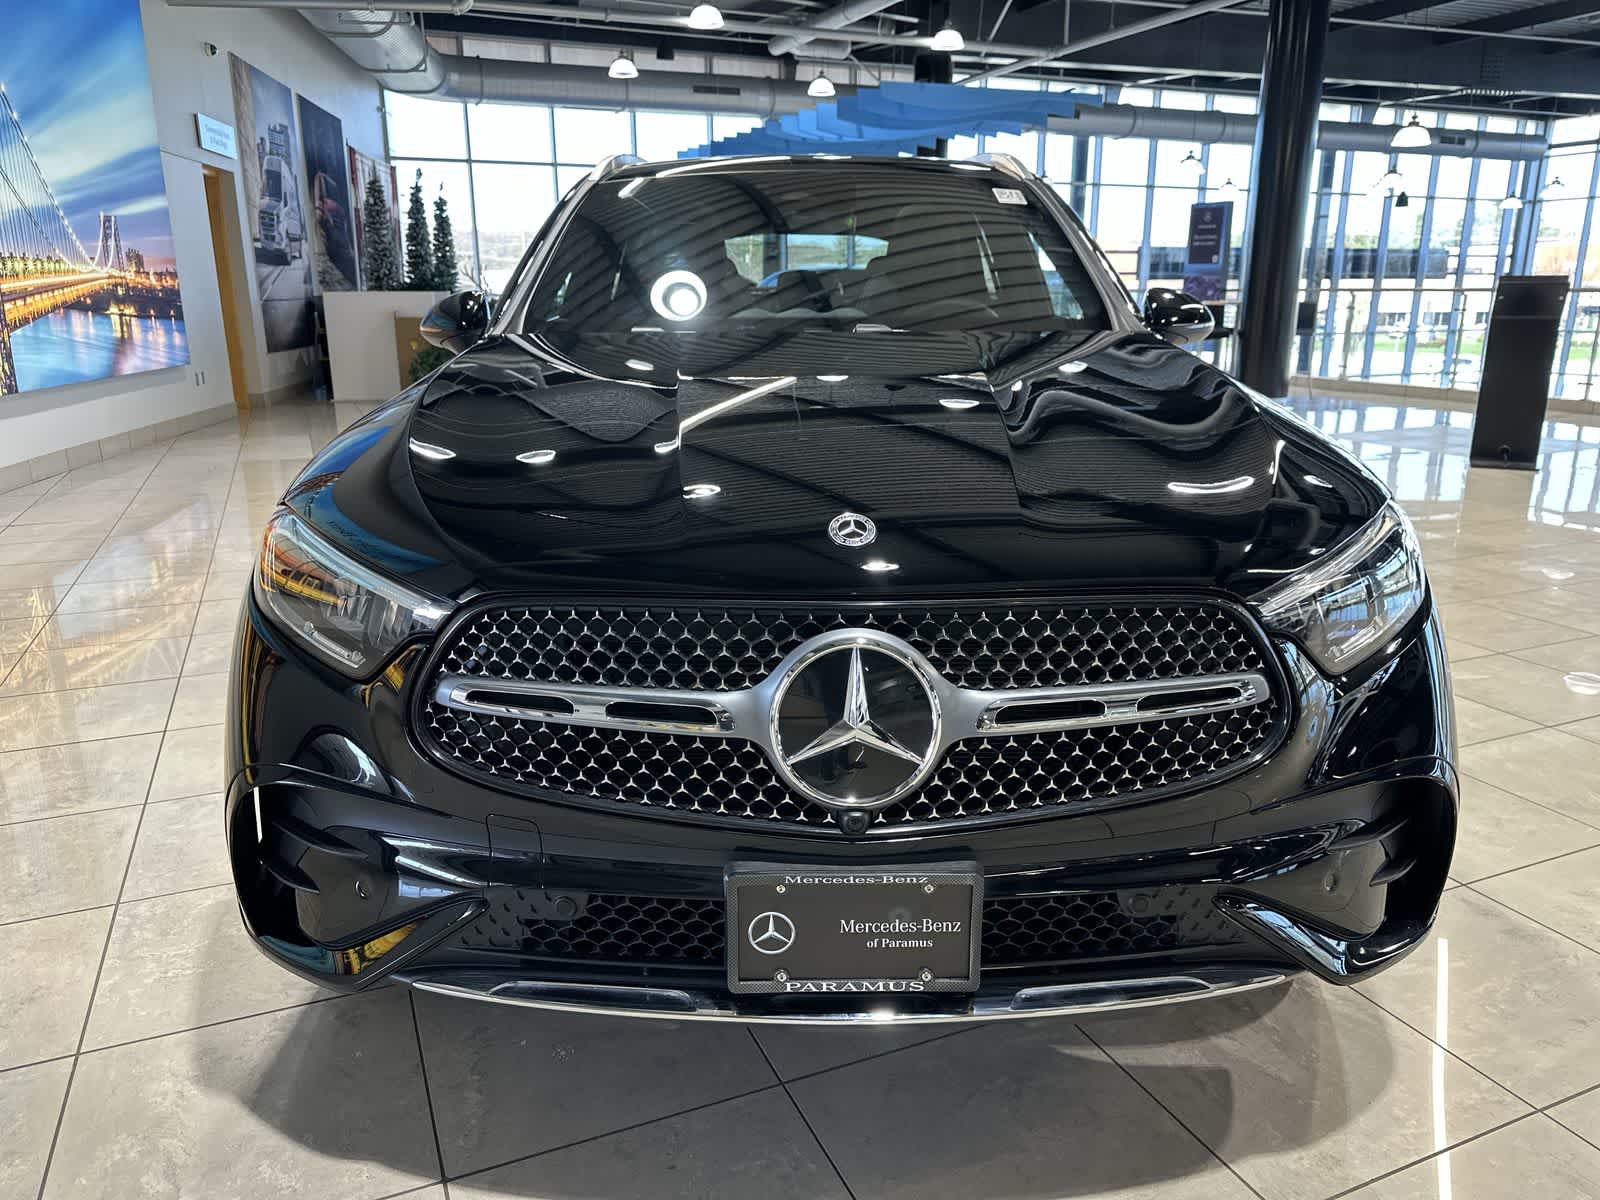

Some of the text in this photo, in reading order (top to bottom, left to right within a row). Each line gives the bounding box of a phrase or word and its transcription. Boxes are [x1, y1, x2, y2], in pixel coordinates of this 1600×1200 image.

[785, 875, 929, 884] Mercedes-Benz
[840, 918, 961, 933] Mercedes-Benz
[866, 938, 934, 948] of Paramus
[784, 981, 925, 992] PARAMUS
